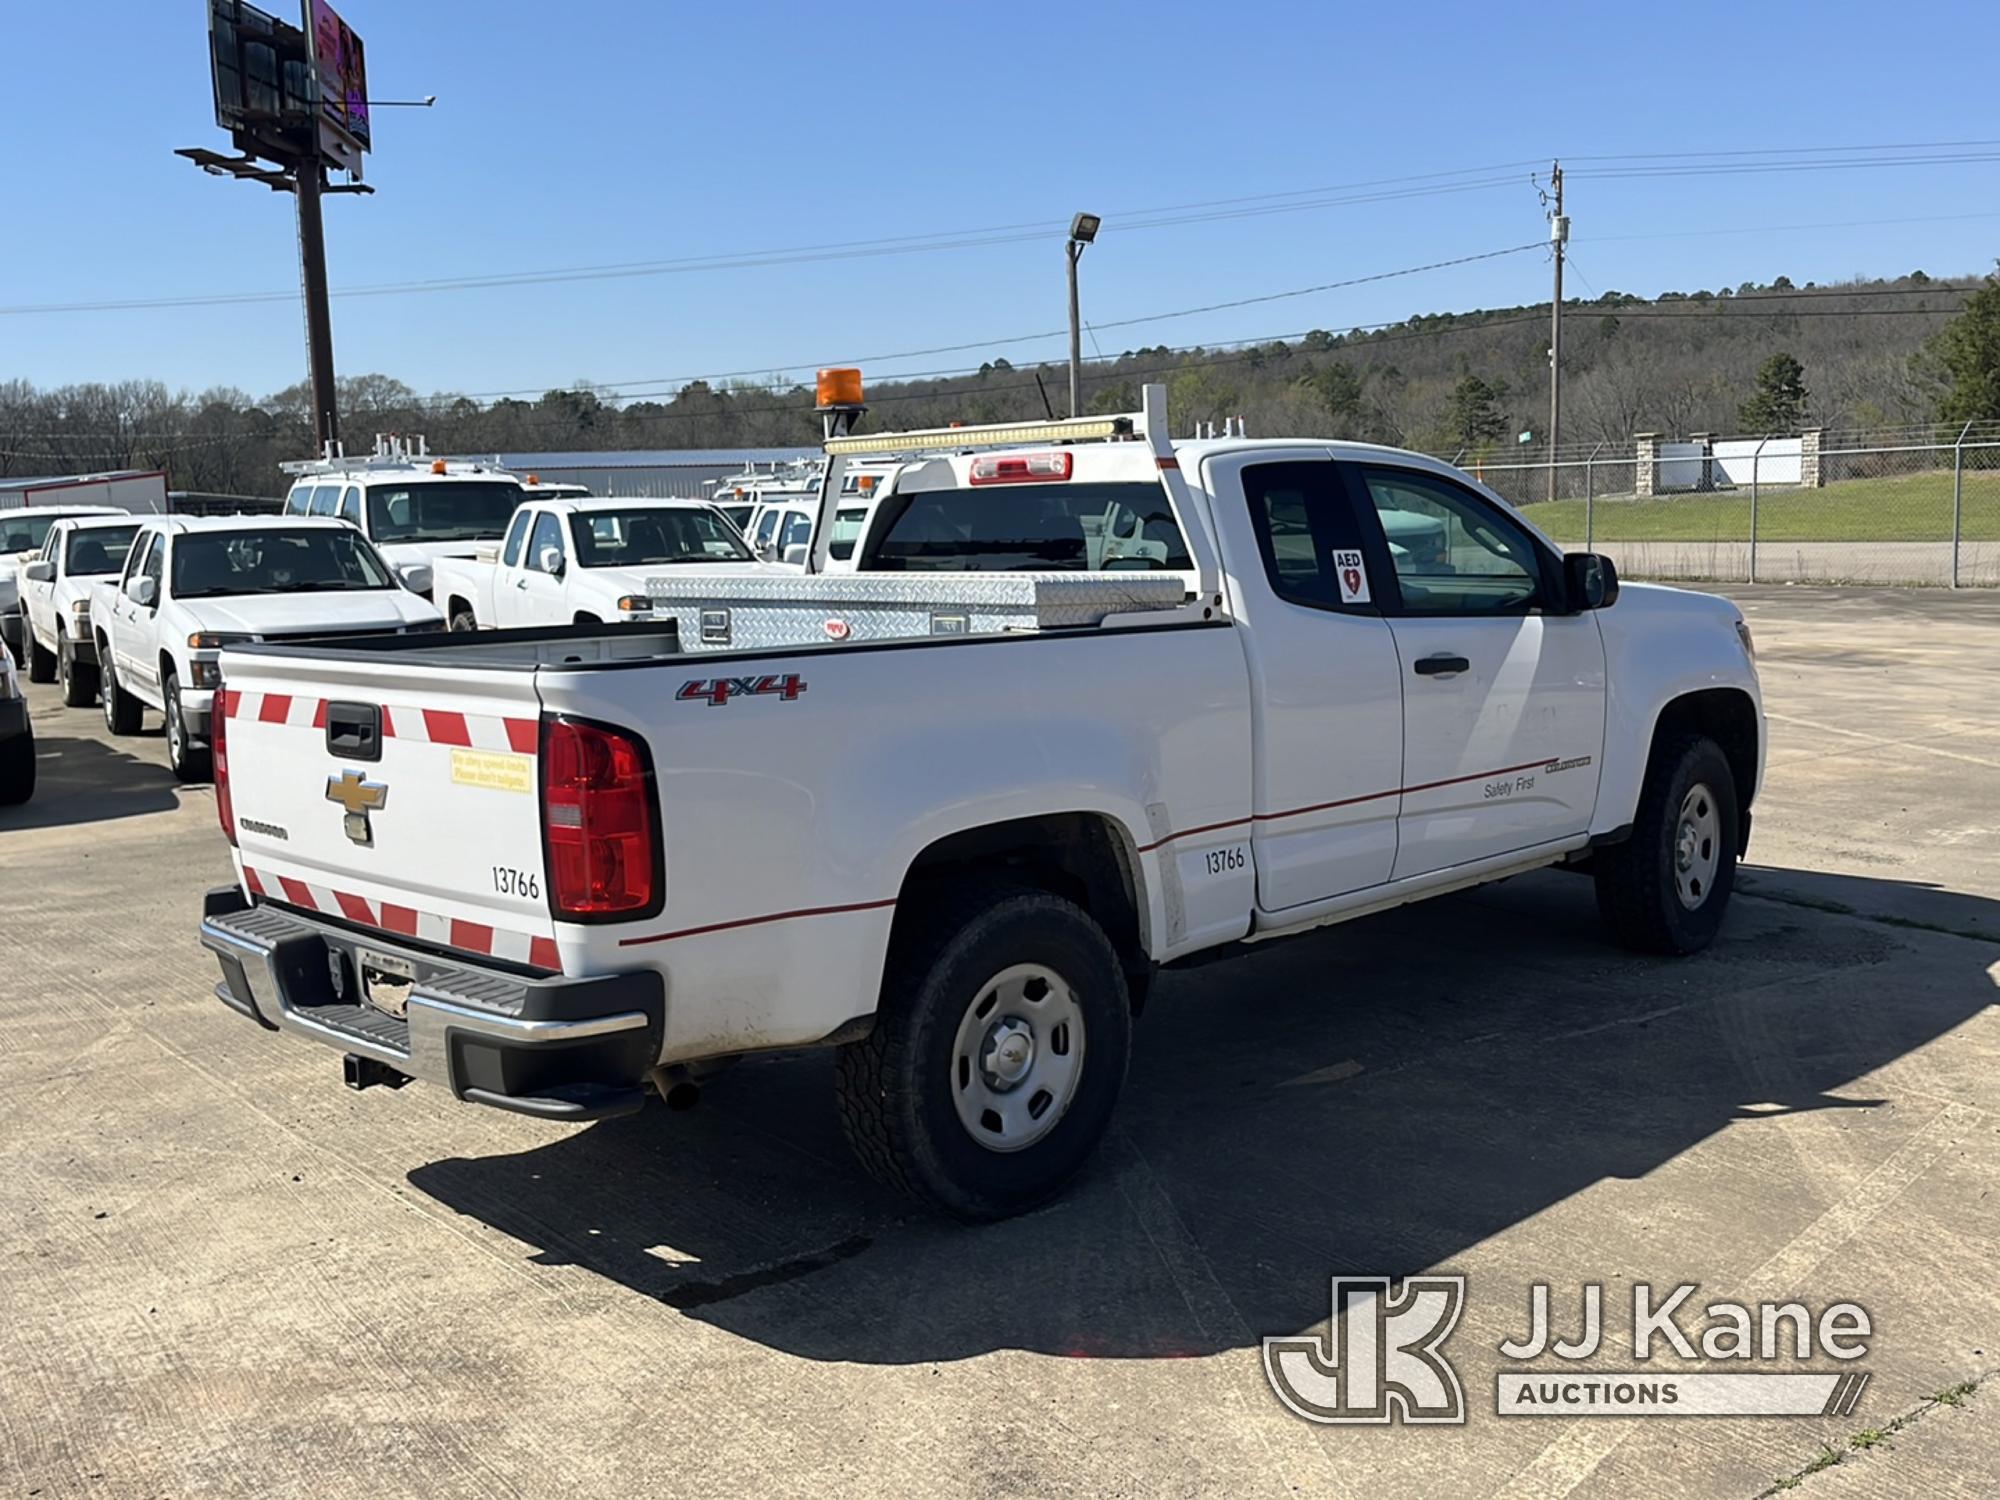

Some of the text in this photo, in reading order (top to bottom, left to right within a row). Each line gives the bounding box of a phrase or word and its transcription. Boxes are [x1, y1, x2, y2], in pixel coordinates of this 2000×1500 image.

[1336, 552, 1361, 568] AED
[1484, 776, 1535, 799] Safety First
[1206, 847, 1245, 875] 13766
[492, 866, 540, 899] 13766
